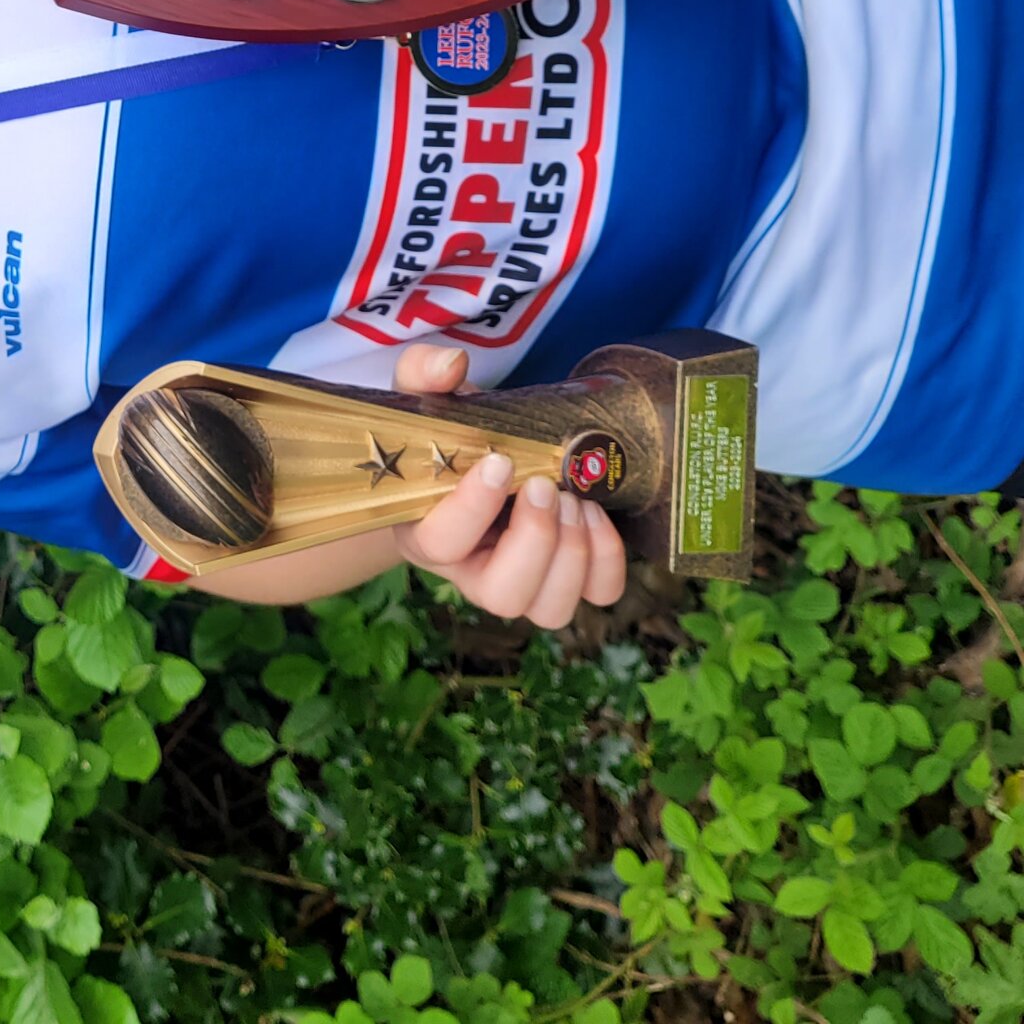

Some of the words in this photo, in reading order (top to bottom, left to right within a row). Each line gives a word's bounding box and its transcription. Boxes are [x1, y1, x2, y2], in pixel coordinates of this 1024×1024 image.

[437, 22, 455, 67] LEE
[537, 53, 578, 140] LTD
[706, 381, 717, 408] YEAR
[705, 410, 716, 430] THE
[704, 433, 715, 446] OF
[687, 451, 701, 516] CONGLETON
[703, 449, 715, 486] PLAYER
[715, 475, 727, 500] MIKE
[701, 510, 712, 546] UNDER
